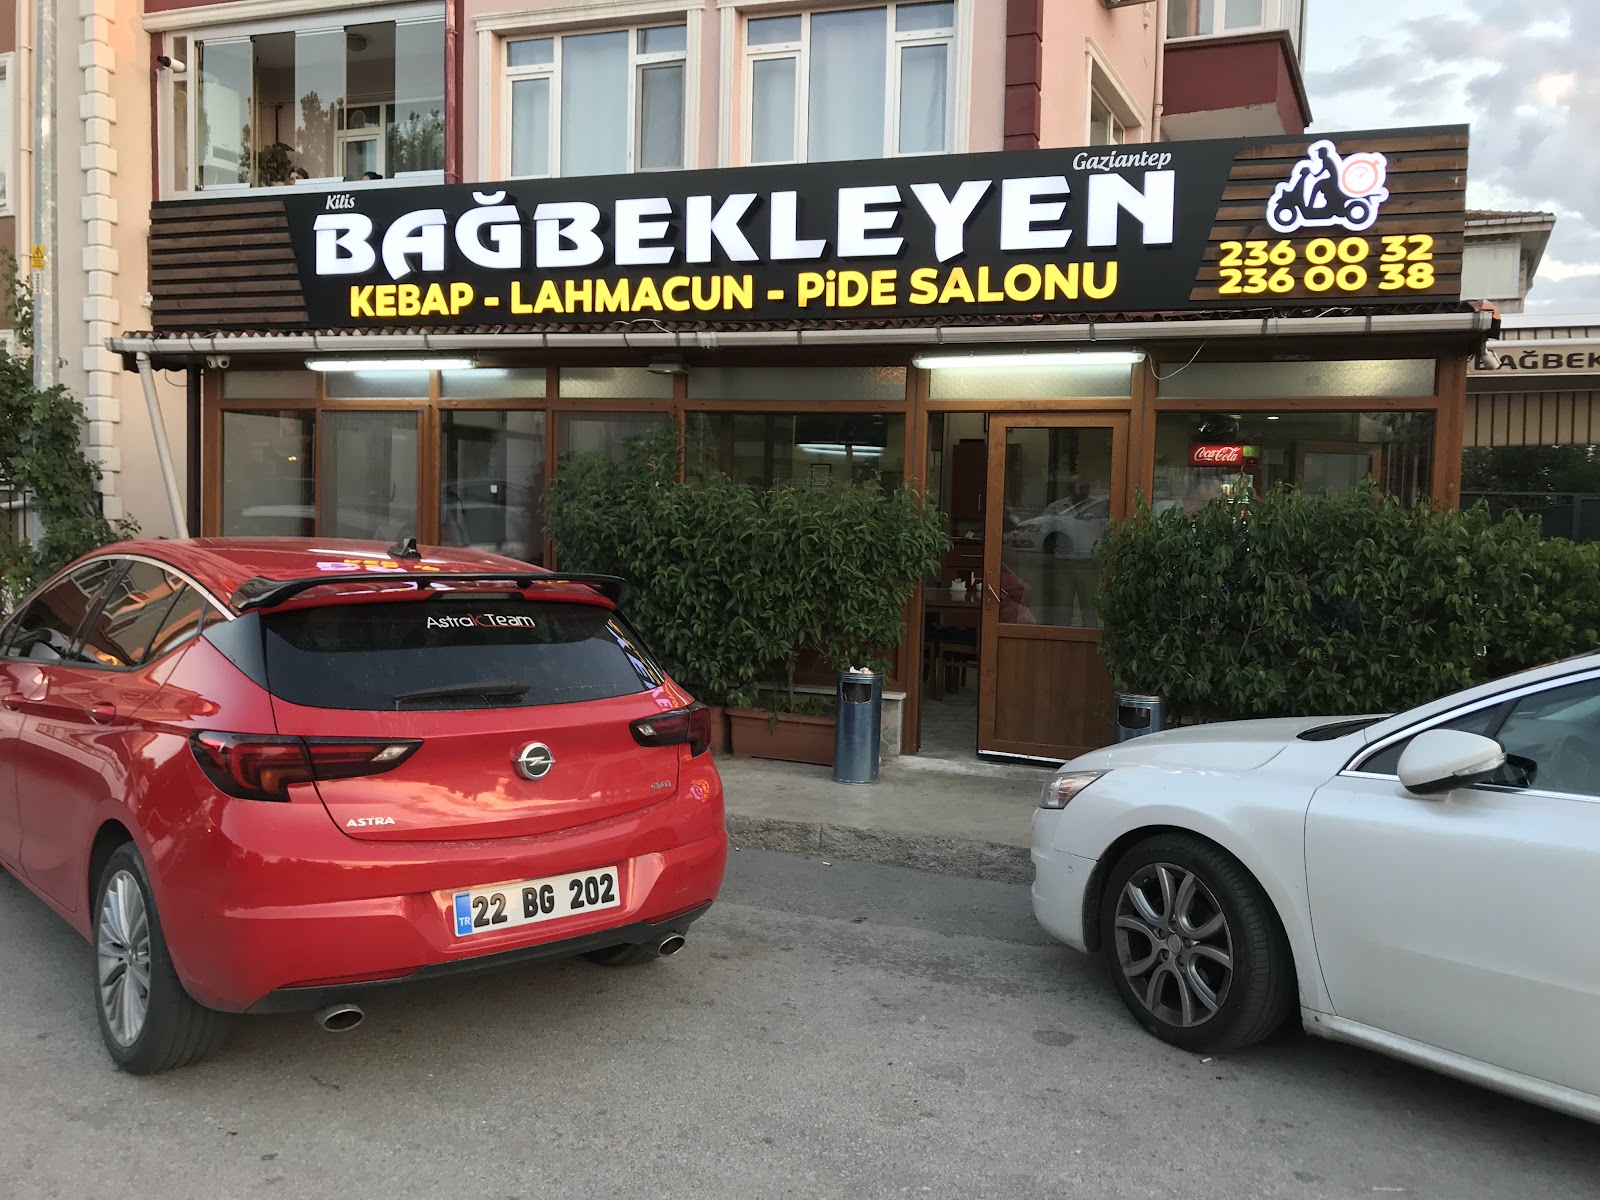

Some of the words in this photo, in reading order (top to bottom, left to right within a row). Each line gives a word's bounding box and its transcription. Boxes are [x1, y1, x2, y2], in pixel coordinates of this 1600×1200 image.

[1073, 151, 1172, 171] Gaziantep
[325, 194, 356, 210] Kilis
[313, 170, 1175, 280] BAĞBEKLEYEN
[1219, 239, 1296, 267] 236
[1304, 237, 1370, 265] 00
[1380, 233, 1434, 262] 32
[350, 282, 474, 317] KEBAP
[510, 275, 754, 314] LAHMACUN
[909, 261, 1118, 304] SALONU
[1218, 267, 1296, 294] 236
[1303, 264, 1368, 292] 00
[1378, 262, 1435, 290] 38
[346, 816, 396, 828] ASTRA
[472, 893, 508, 928] 22
[522, 884, 555, 918] BG
[568, 873, 615, 910] 202
[458, 917, 471, 926] TR
